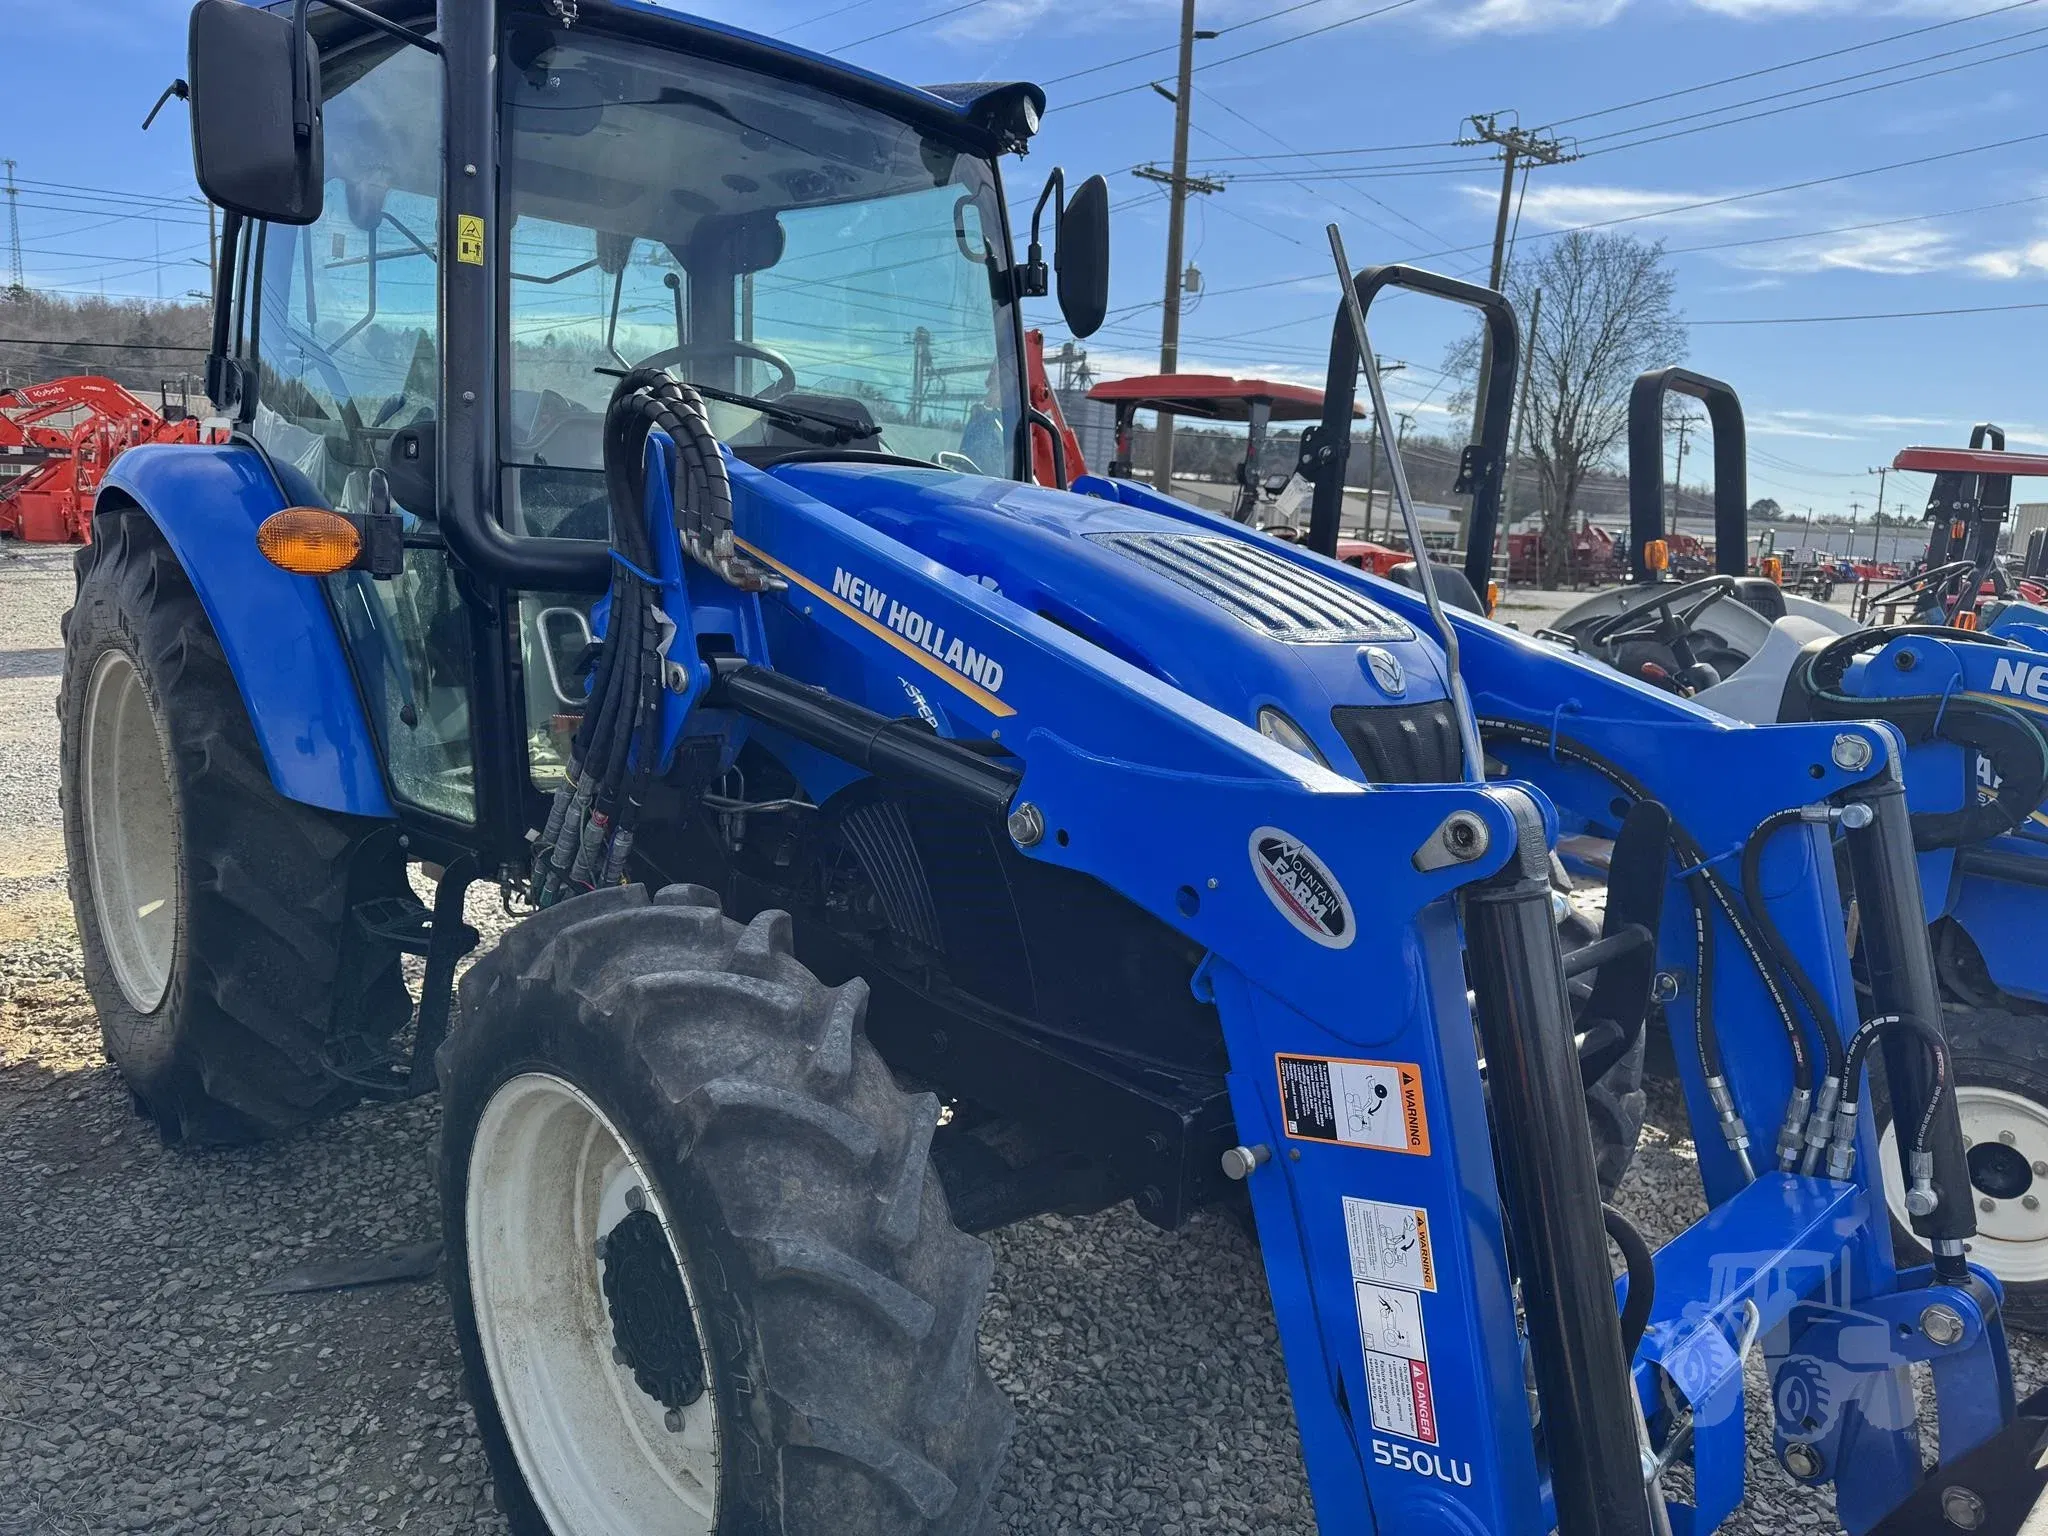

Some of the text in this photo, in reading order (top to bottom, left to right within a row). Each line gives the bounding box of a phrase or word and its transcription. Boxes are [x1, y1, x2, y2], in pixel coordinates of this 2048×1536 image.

[32, 386, 65, 398] Kubota
[832, 565, 1004, 693] NEW HOLLAND
[1266, 840, 1340, 916] MOUNTAIN
[1272, 856, 1328, 921] FARM
[1405, 1089, 1421, 1147] WARNING
[1419, 1231, 1432, 1283] WARNING
[1416, 1381, 1431, 1436] DANGER
[1372, 1439, 1472, 1486] 550LU
